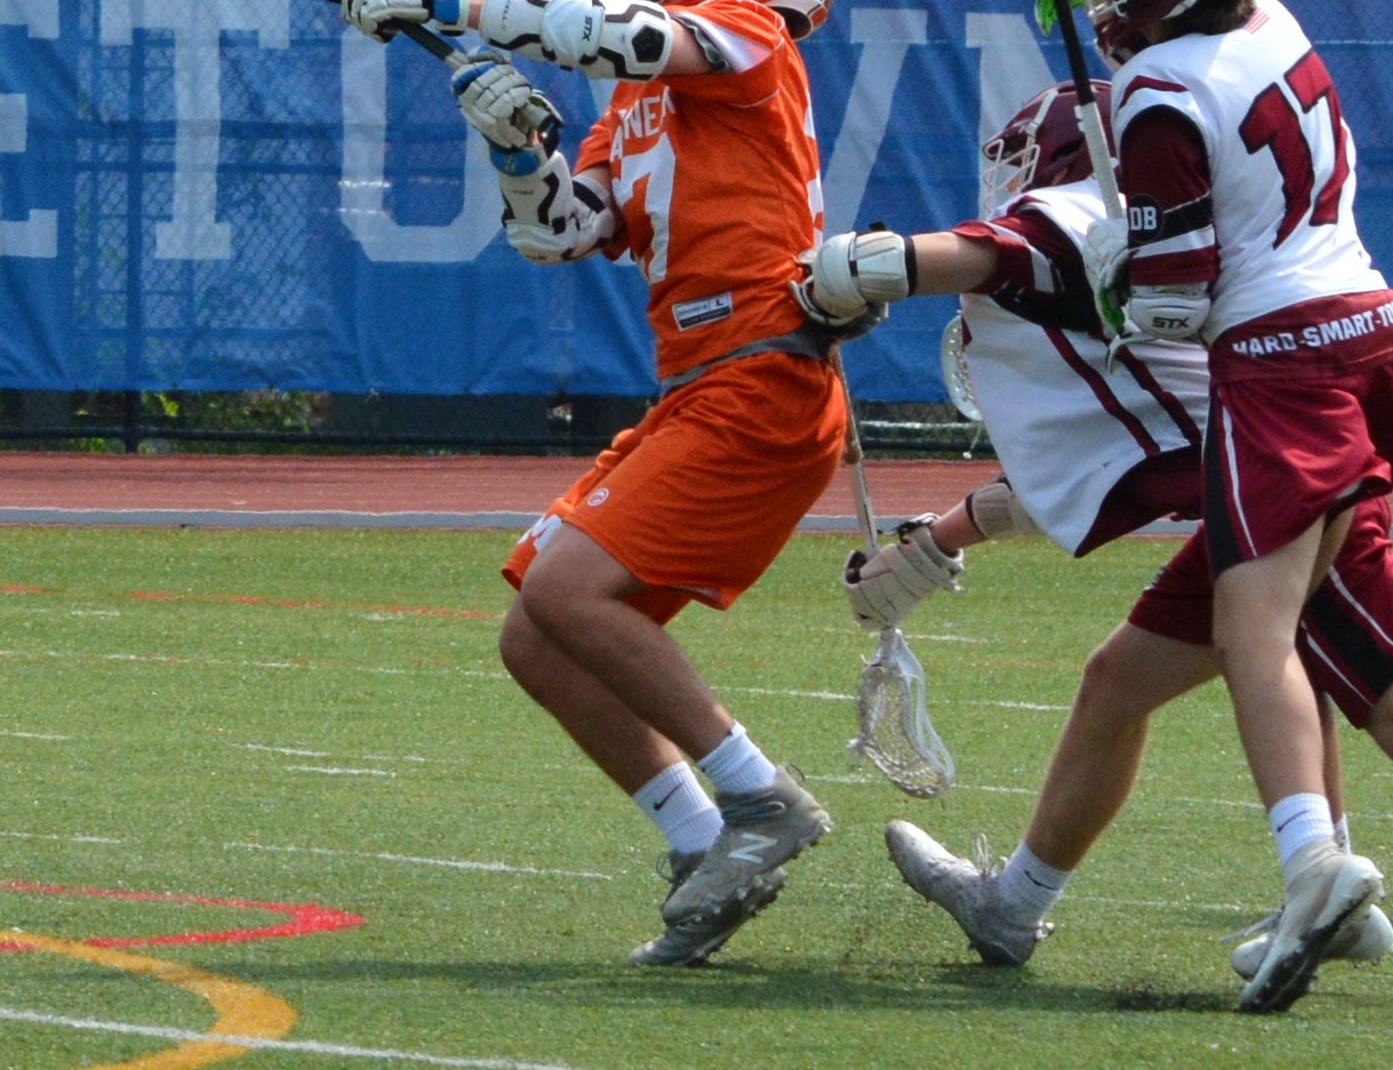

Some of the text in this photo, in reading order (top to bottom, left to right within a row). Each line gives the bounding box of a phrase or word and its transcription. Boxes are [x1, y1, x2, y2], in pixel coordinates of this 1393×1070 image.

[581, 15, 594, 42] STX
[1238, 48, 1350, 251] 17
[1129, 206, 1157, 231] DB
[1152, 316, 1191, 329] STX
